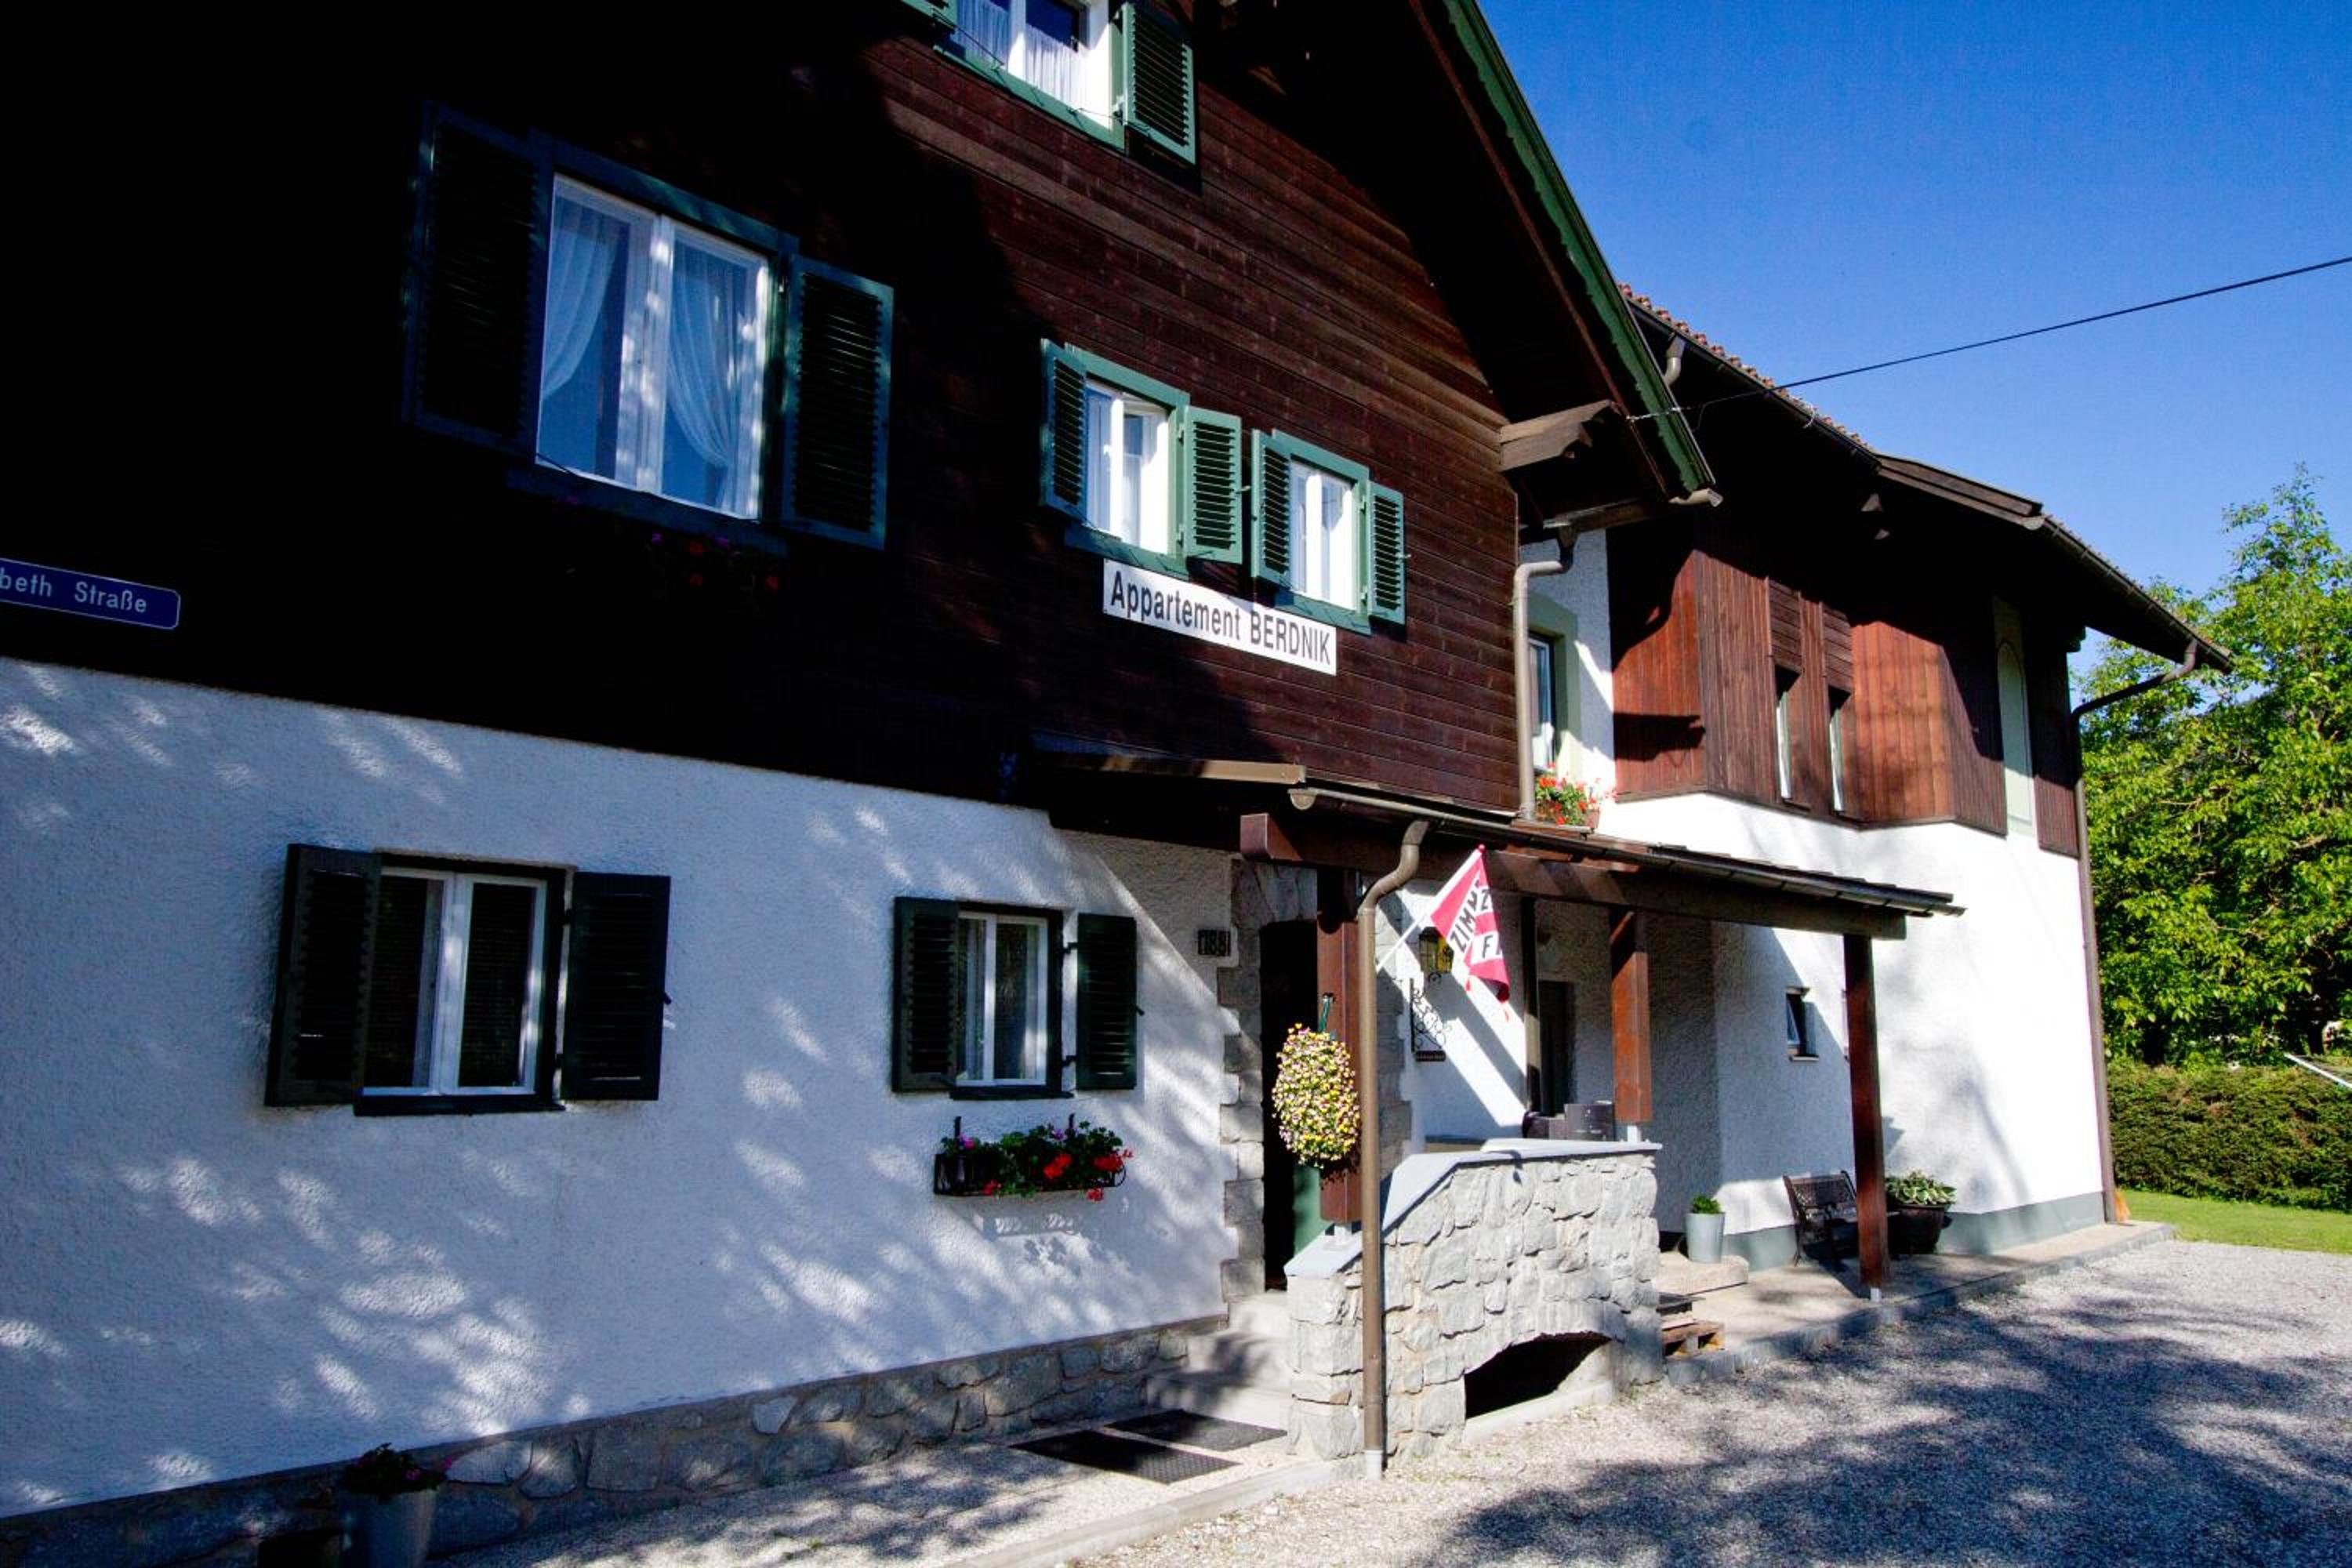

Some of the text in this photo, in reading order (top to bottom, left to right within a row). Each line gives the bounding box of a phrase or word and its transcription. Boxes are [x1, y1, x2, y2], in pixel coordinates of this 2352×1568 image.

[74, 580, 147, 614] Straße
[1110, 570, 1331, 666] Appartement BERDNIK
